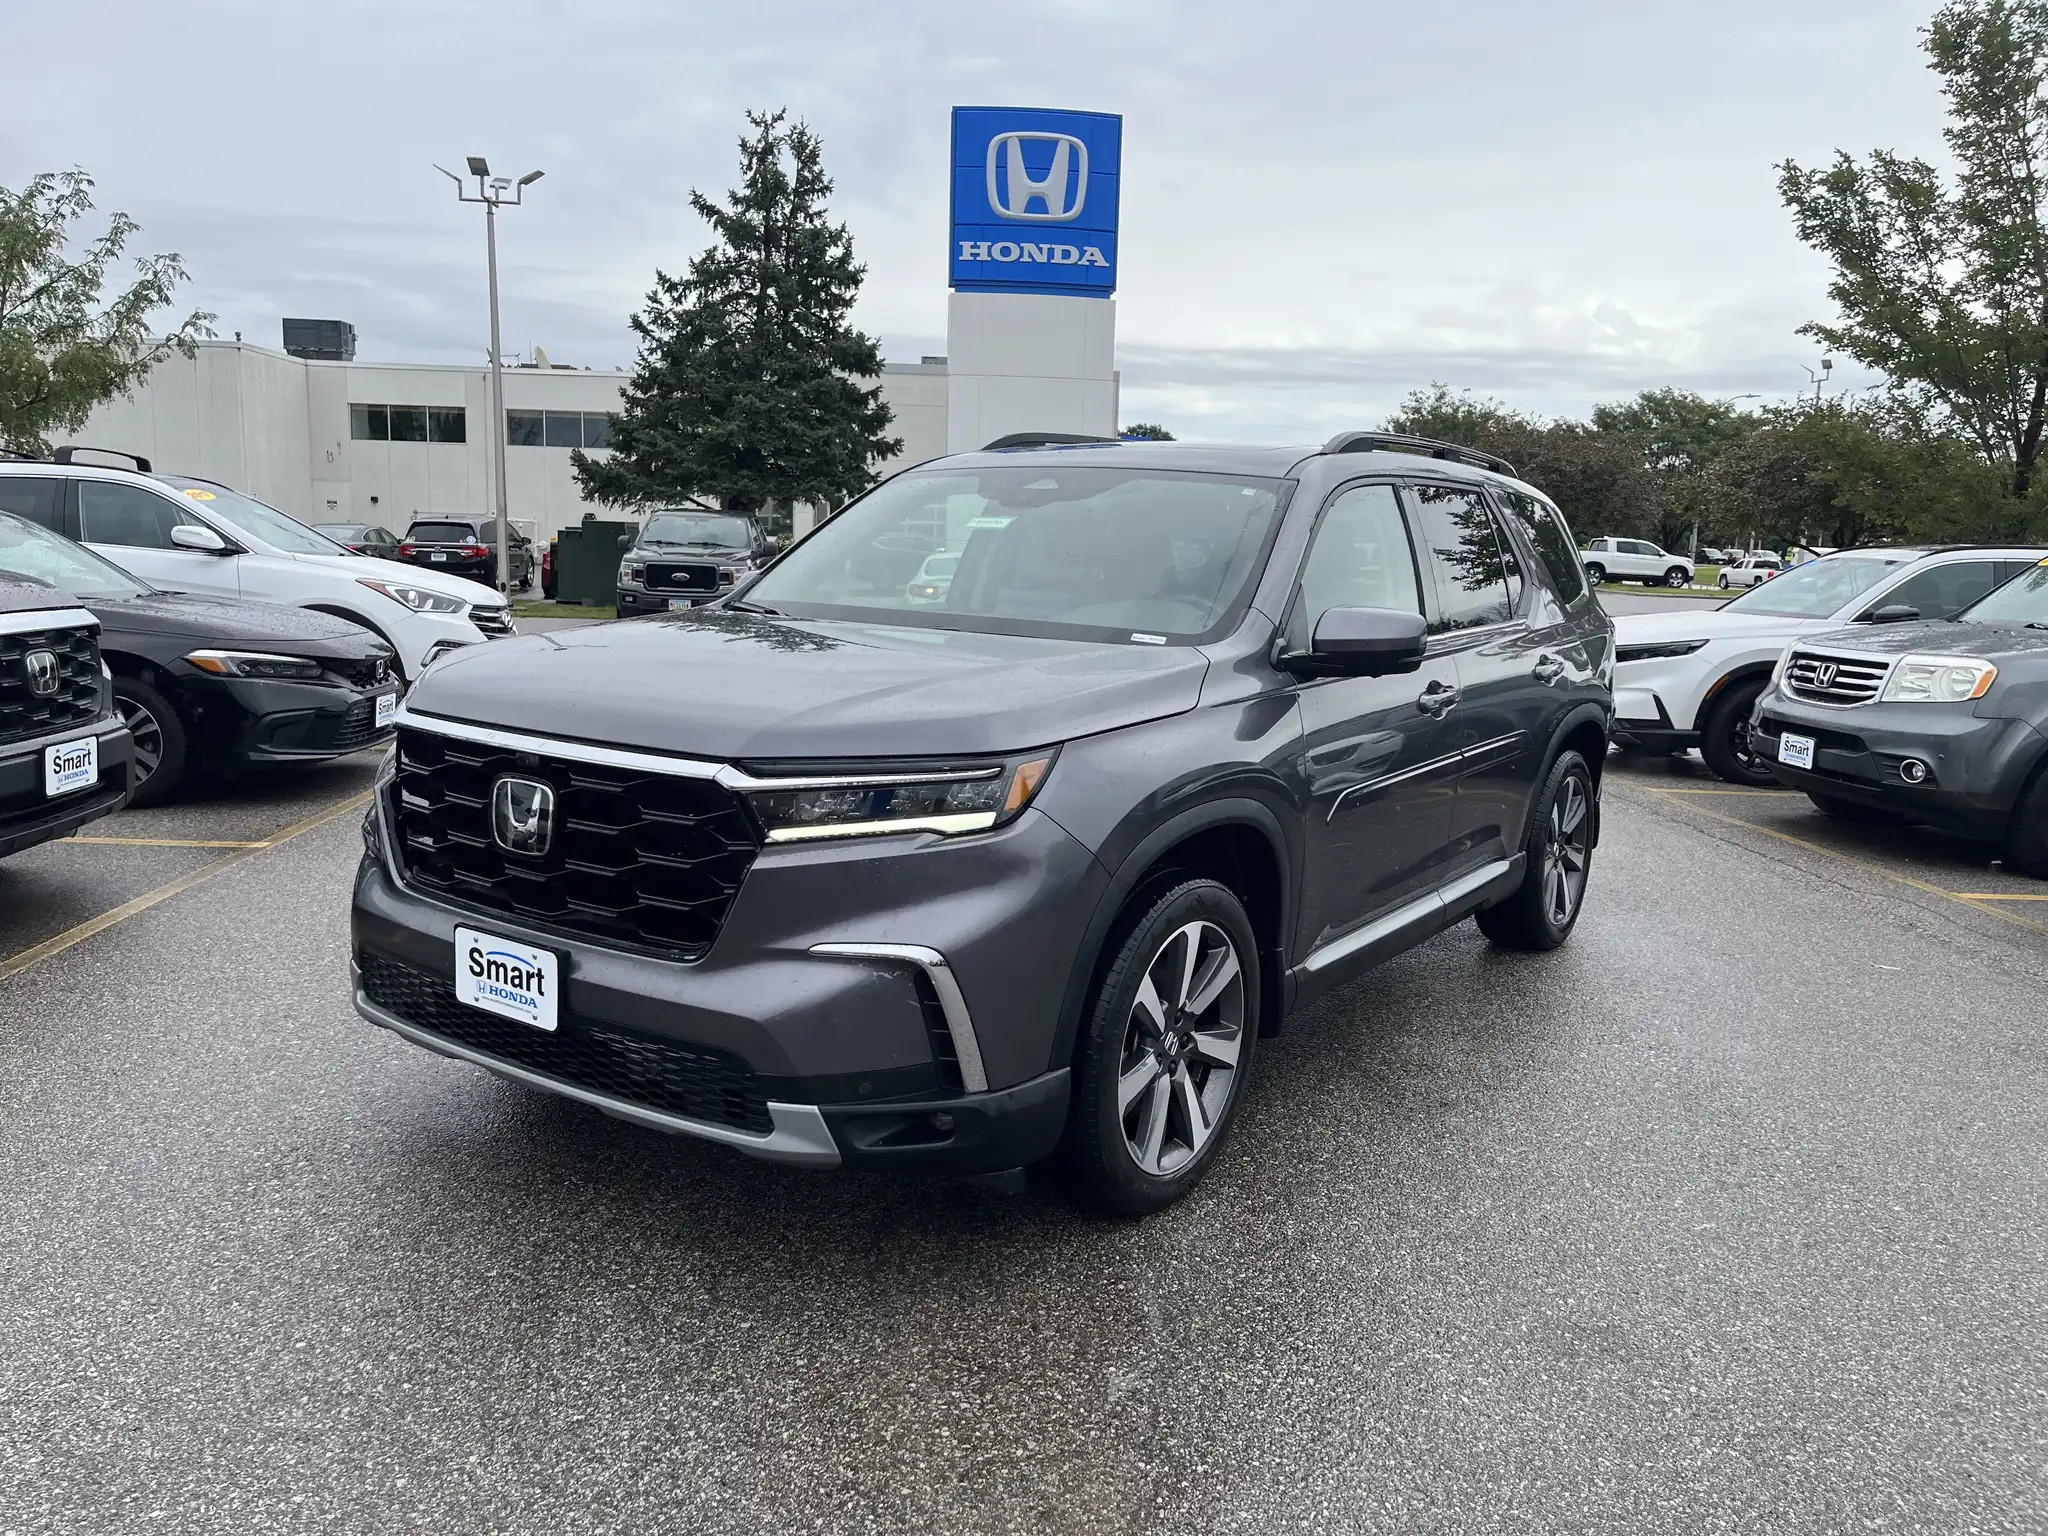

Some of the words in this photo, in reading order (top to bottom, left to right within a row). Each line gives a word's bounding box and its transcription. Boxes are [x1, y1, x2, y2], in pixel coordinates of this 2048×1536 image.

[958, 241, 1110, 267] HONDA
[53, 748, 92, 774] Smart
[1784, 740, 1809, 757] Smart
[64, 769, 89, 781] HONDA
[468, 947, 545, 997] Smart
[488, 984, 538, 1009] HONDA
